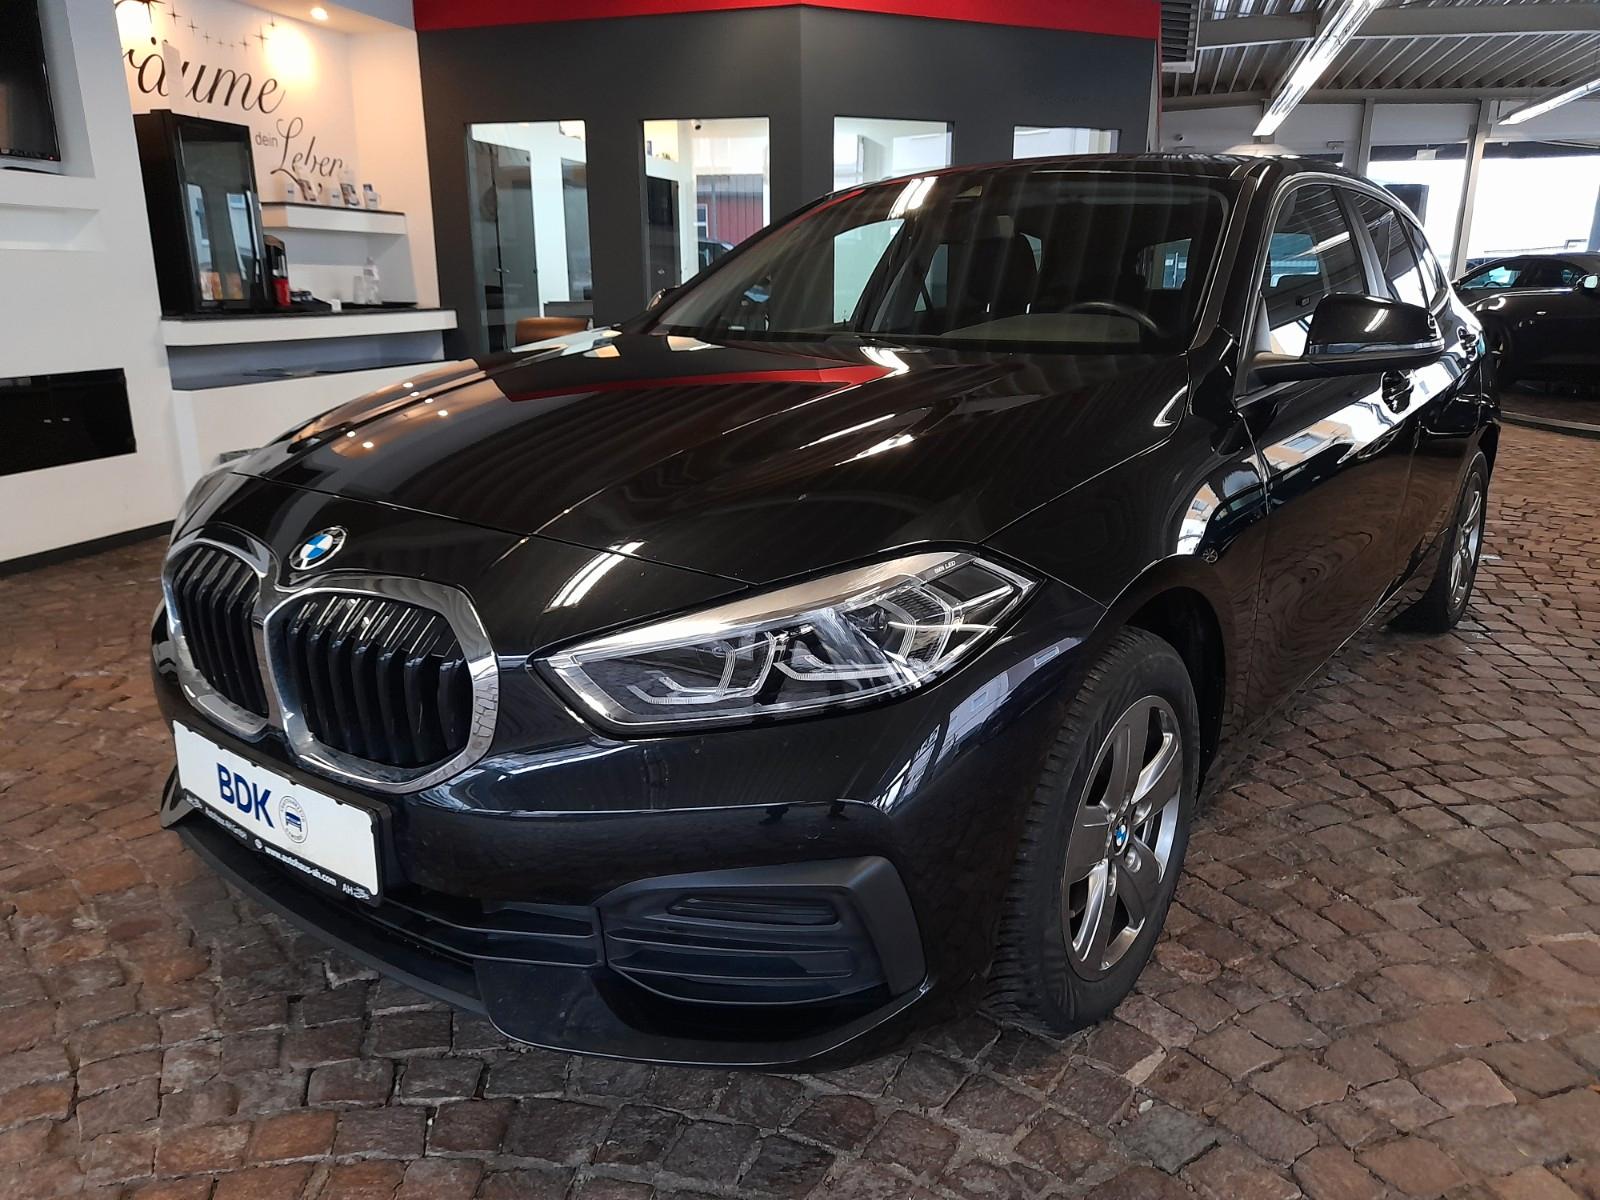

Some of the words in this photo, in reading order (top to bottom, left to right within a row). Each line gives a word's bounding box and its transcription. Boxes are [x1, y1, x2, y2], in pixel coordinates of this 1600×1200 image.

[123, 36, 286, 114] räume
[254, 131, 279, 148] dein
[217, 762, 275, 829] BDK
